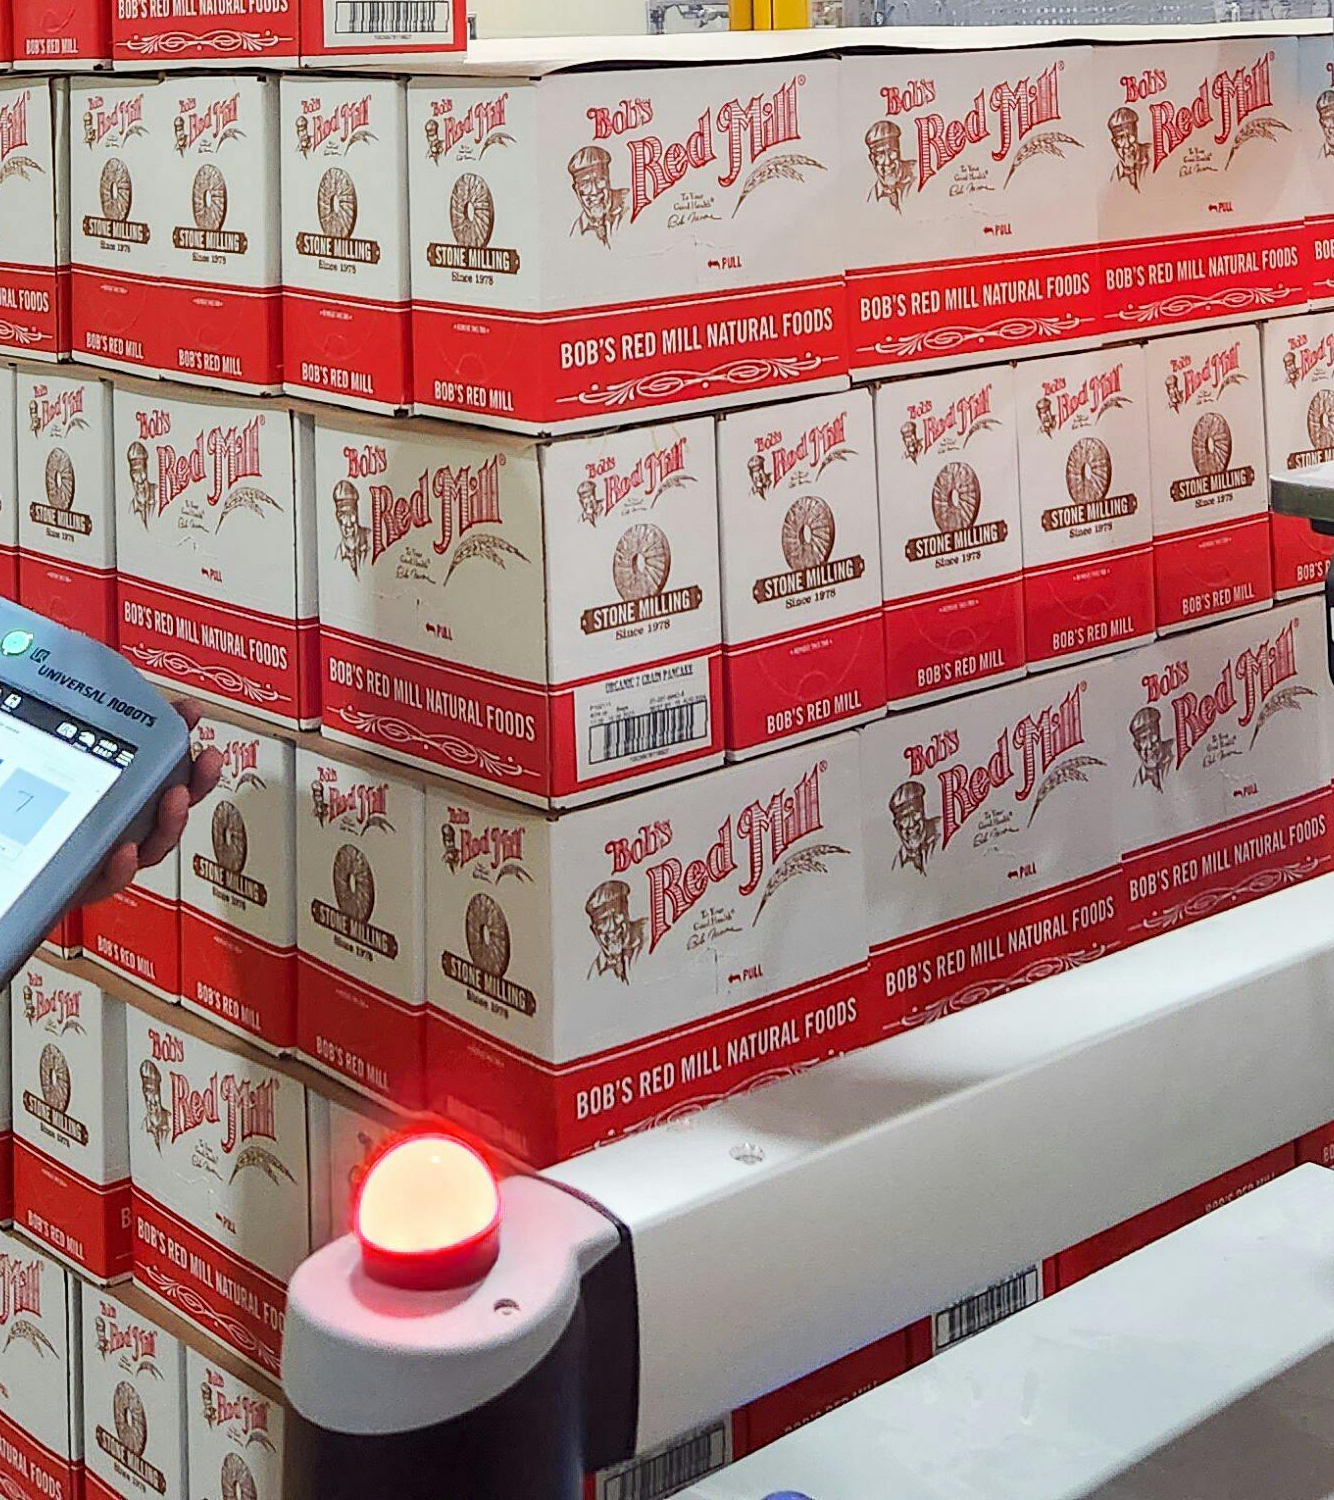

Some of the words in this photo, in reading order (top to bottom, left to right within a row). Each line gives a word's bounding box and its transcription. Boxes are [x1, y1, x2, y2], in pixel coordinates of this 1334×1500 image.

[880, 79, 935, 116] Bob's
[587, 98, 653, 140] Bob's
[915, 89, 990, 192] Red
[990, 62, 1060, 161] Mill
[627, 107, 716, 224] Red
[717, 76, 801, 187] Mill
[995, 224, 1011, 236] PULL
[435, 246, 466, 267] STONE
[468, 249, 510, 272] MILLING
[451, 271, 473, 283] Since
[476, 275, 494, 285] 1978
[722, 256, 742, 269] PULL
[18, 290, 49, 312] FOODS
[860, 293, 907, 322] BOB'S
[911, 291, 939, 317] RED
[945, 285, 979, 312] MILL
[983, 279, 1043, 306] NATURAL
[1047, 273, 1089, 298] FOODS
[560, 337, 616, 369] BOB'S
[622, 332, 656, 360] RED
[662, 326, 702, 353] MILL
[707, 316, 778, 349] NATURAL
[783, 308, 833, 337] FOODS
[434, 380, 464, 404] BOB'S
[466, 386, 487, 406] RED
[489, 389, 515, 411] MILL
[344, 445, 387, 478] Bob's
[369, 468, 432, 565] Red
[432, 453, 502, 554] Mill
[764, 574, 803, 598] STONE
[806, 559, 855, 587] MILLING
[593, 603, 635, 630] STONE
[639, 591, 690, 620] MILLING
[616, 626, 644, 640] Since
[647, 619, 671, 633] 1978
[437, 625, 452, 640] PULL
[38, 665, 106, 704] UNIVERSAL
[107, 697, 158, 727] ROBOTS
[329, 657, 364, 690] BOB'S
[366, 670, 390, 698] RED
[394, 678, 423, 709] MILL
[427, 688, 483, 728] NATURAL
[486, 705, 535, 741] FOODS
[605, 818, 673, 875] Bob's
[647, 815, 738, 954] Red
[738, 763, 823, 896] Mill
[743, 964, 763, 982] PULL
[576, 1076, 633, 1120] BOB'S
[639, 1063, 675, 1098] RED
[680, 1049, 722, 1084] MILL
[726, 1020, 800, 1066] NATURAL
[805, 997, 857, 1038] FOODS
